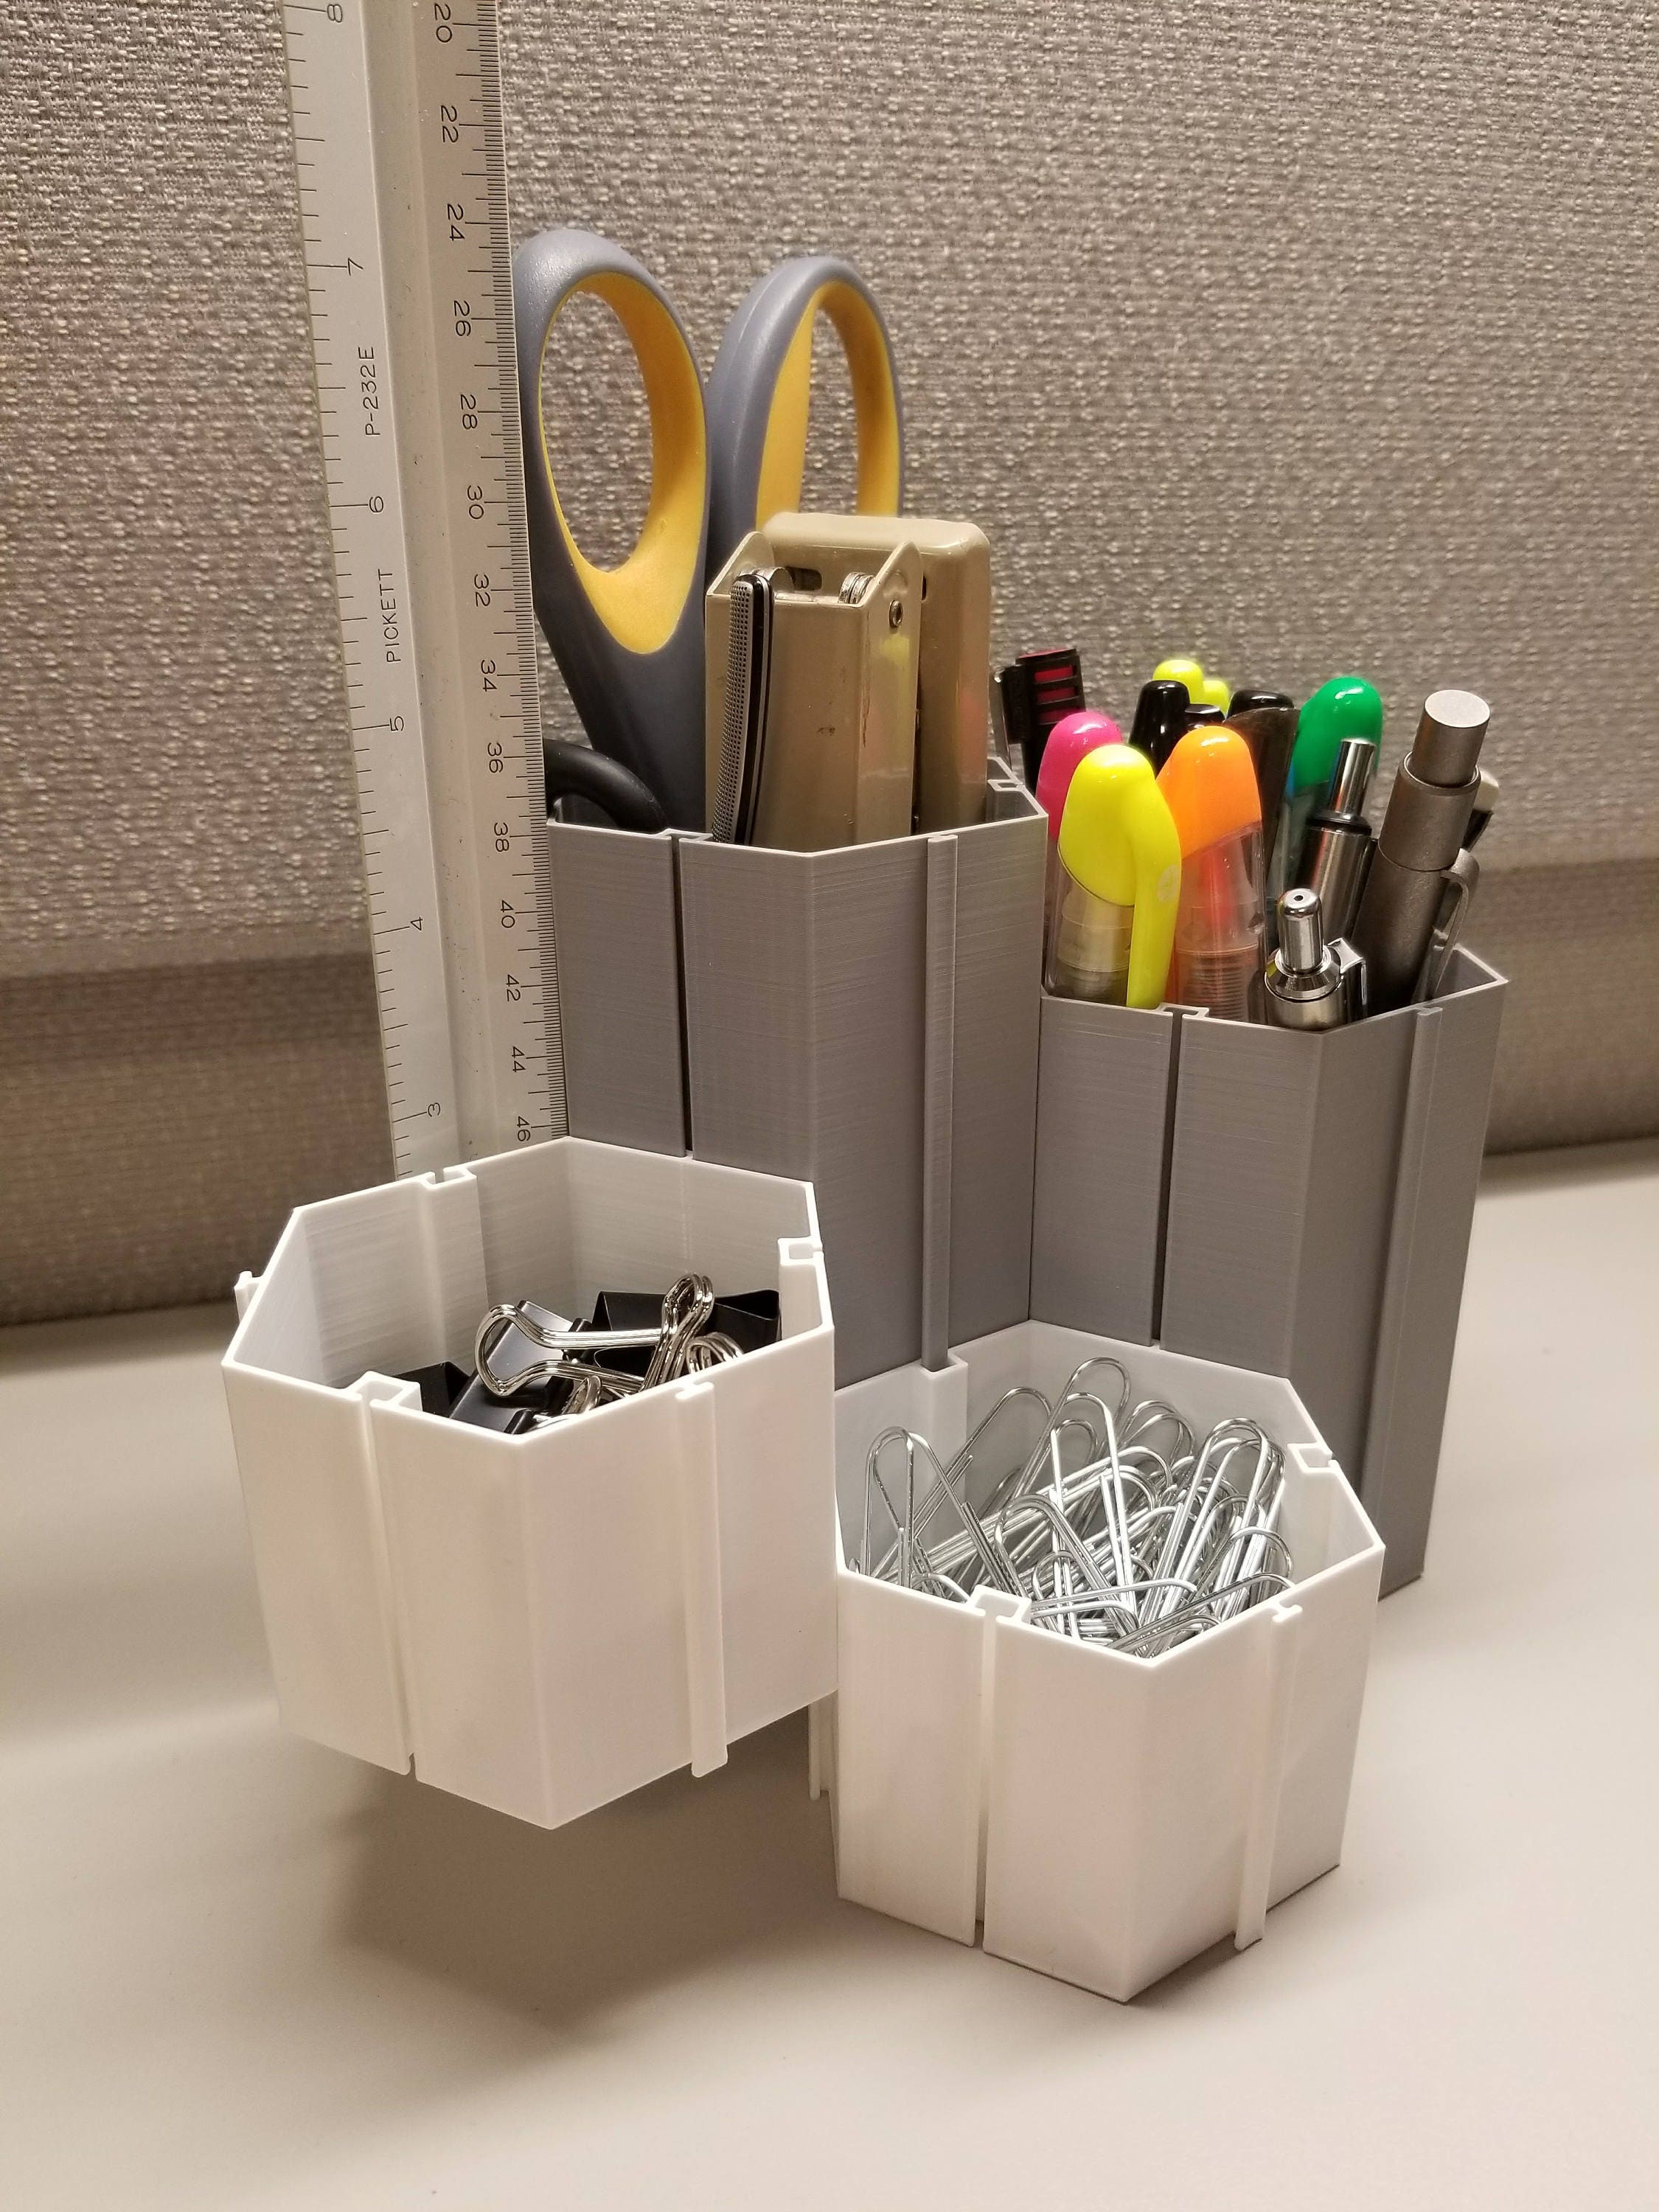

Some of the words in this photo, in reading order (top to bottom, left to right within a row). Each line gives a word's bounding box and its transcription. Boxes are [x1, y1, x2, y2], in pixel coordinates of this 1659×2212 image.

[326, 3, 344, 24] 8
[434, 3, 453, 44] 20
[440, 105, 459, 143] 22
[447, 203, 466, 242] 24
[347, 257, 364, 276] 7
[453, 299, 472, 337] 26
[358, 346, 380, 437] P-232E
[460, 394, 478, 431] 28
[369, 495, 384, 513] 6
[467, 484, 484, 520] 30
[474, 573, 490, 608] 32
[378, 568, 402, 663] PICKETT
[480, 659, 498, 692] 34
[389, 715, 405, 732] 5
[487, 742, 504, 773] 36
[493, 821, 510, 852] 38
[410, 916, 423, 931] 4
[500, 900, 516, 929] 40
[506, 974, 521, 1002] 42
[511, 1046, 526, 1073] 44
[427, 1102, 441, 1118] 3
[516, 1115, 531, 1142] 46
